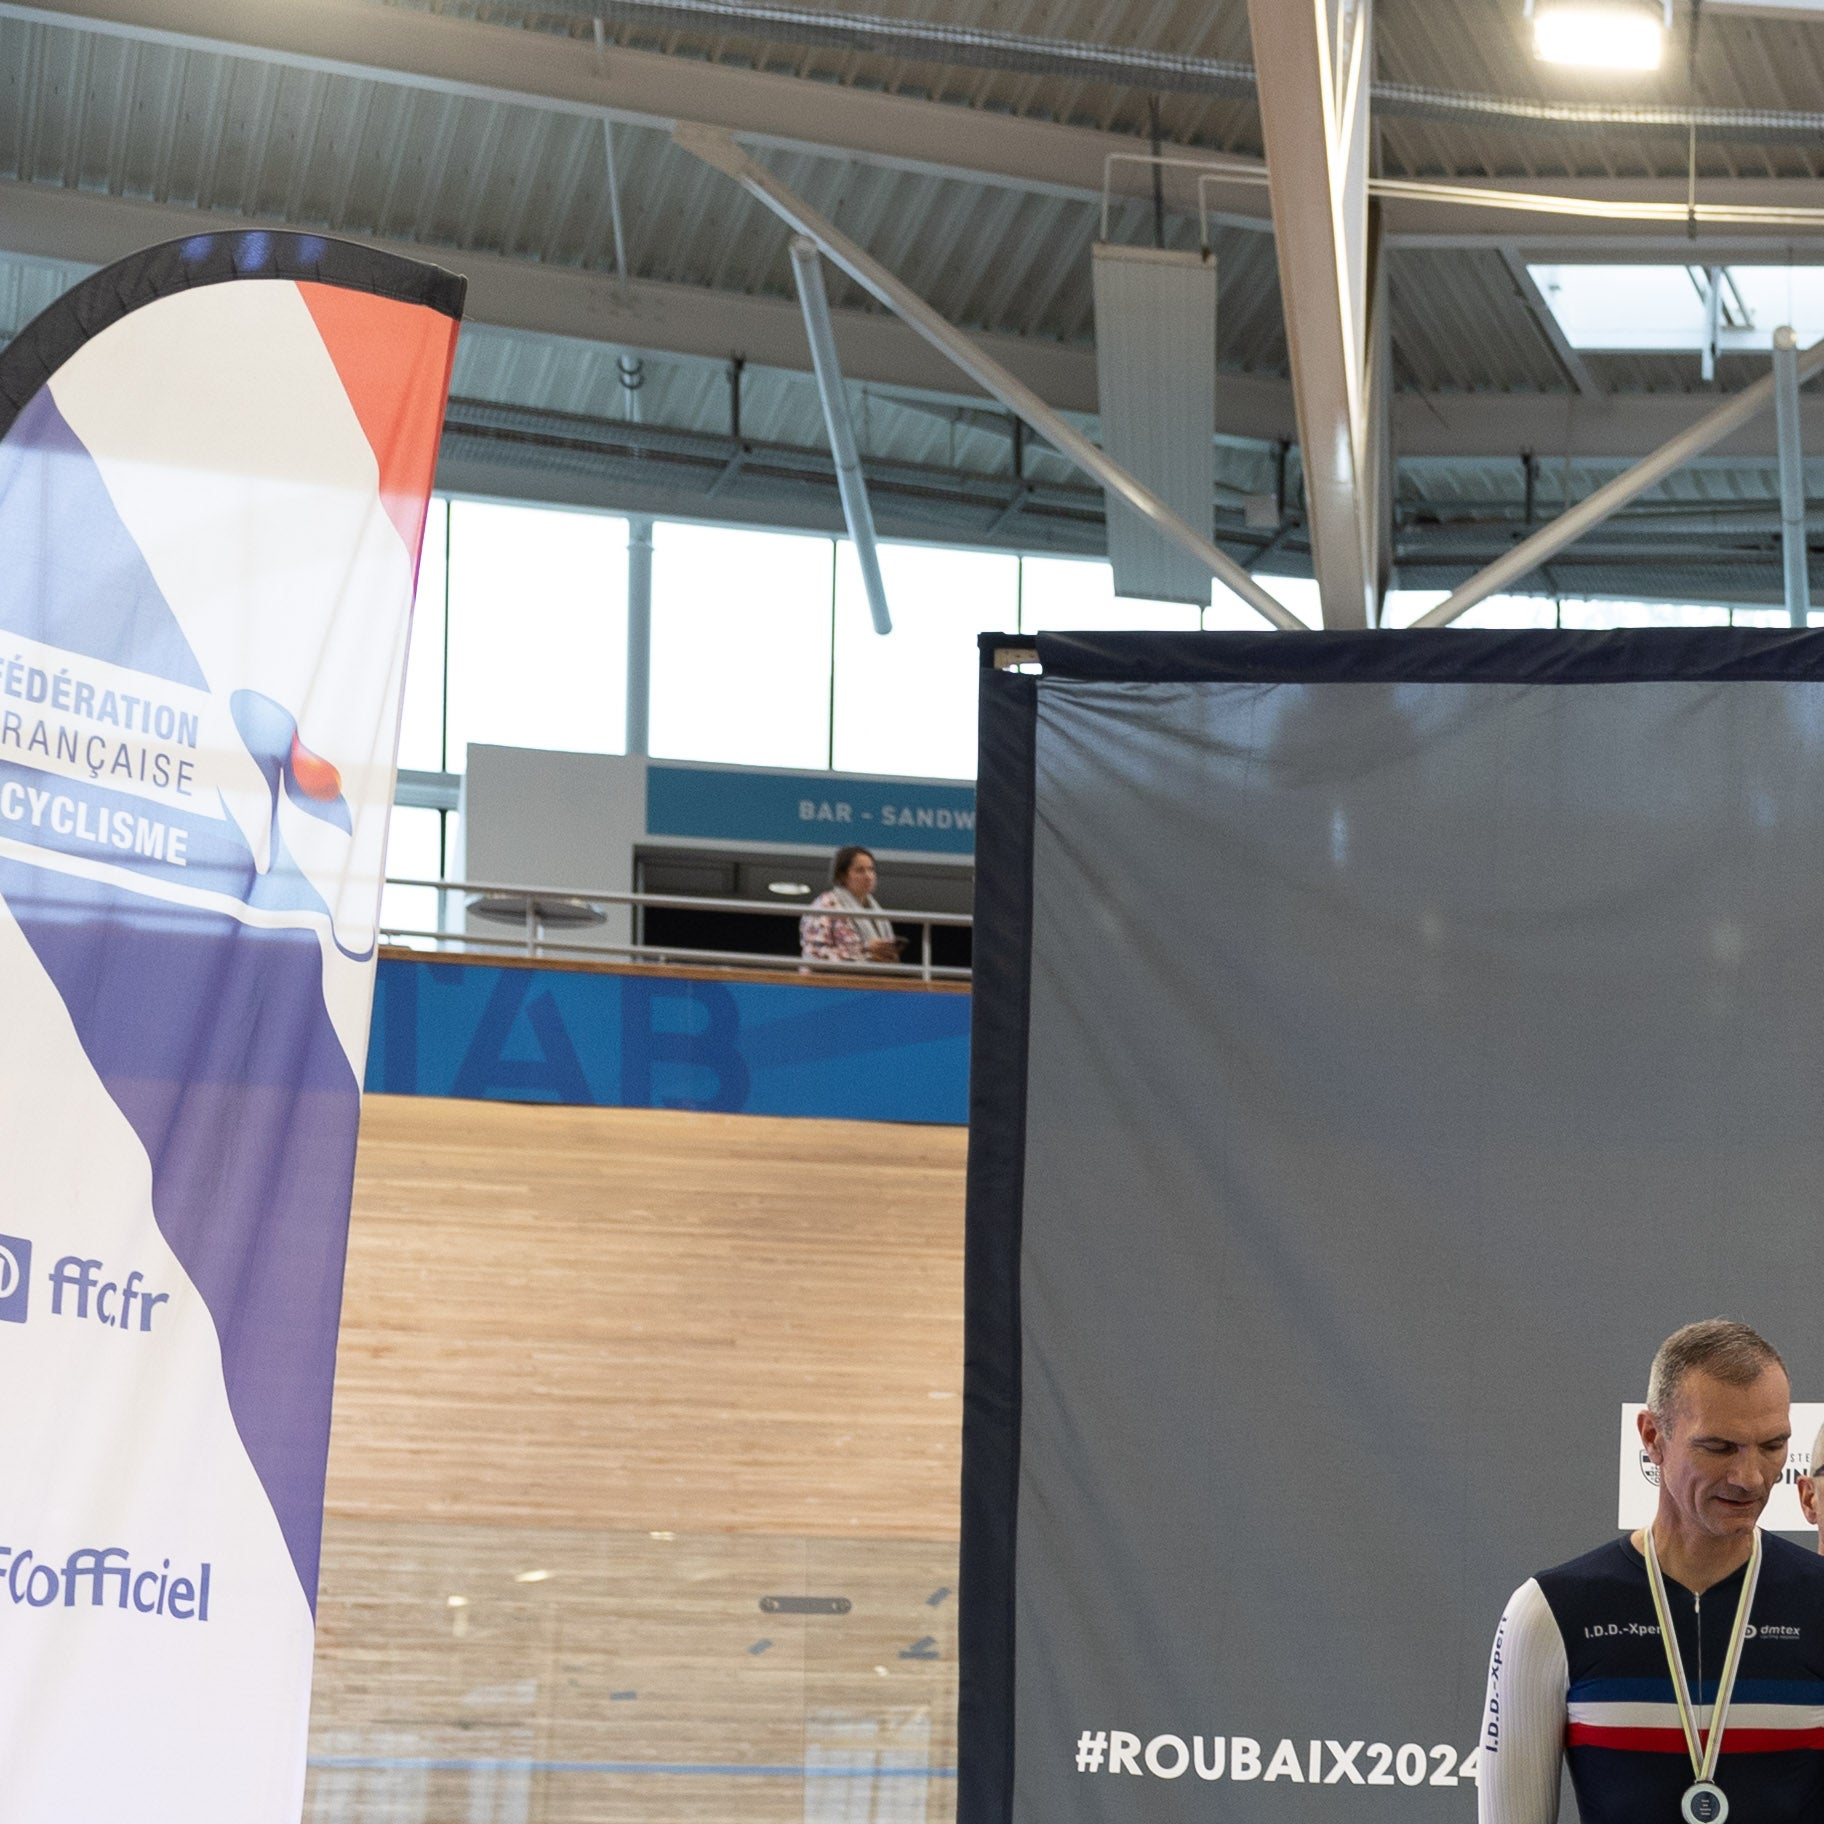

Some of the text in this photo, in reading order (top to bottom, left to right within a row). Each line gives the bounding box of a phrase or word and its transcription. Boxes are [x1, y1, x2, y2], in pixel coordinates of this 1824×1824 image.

[797, 800, 852, 823] BAR
[1, 781, 189, 866] CYCLISME
[1760, 1624, 1801, 1636] dmtex
